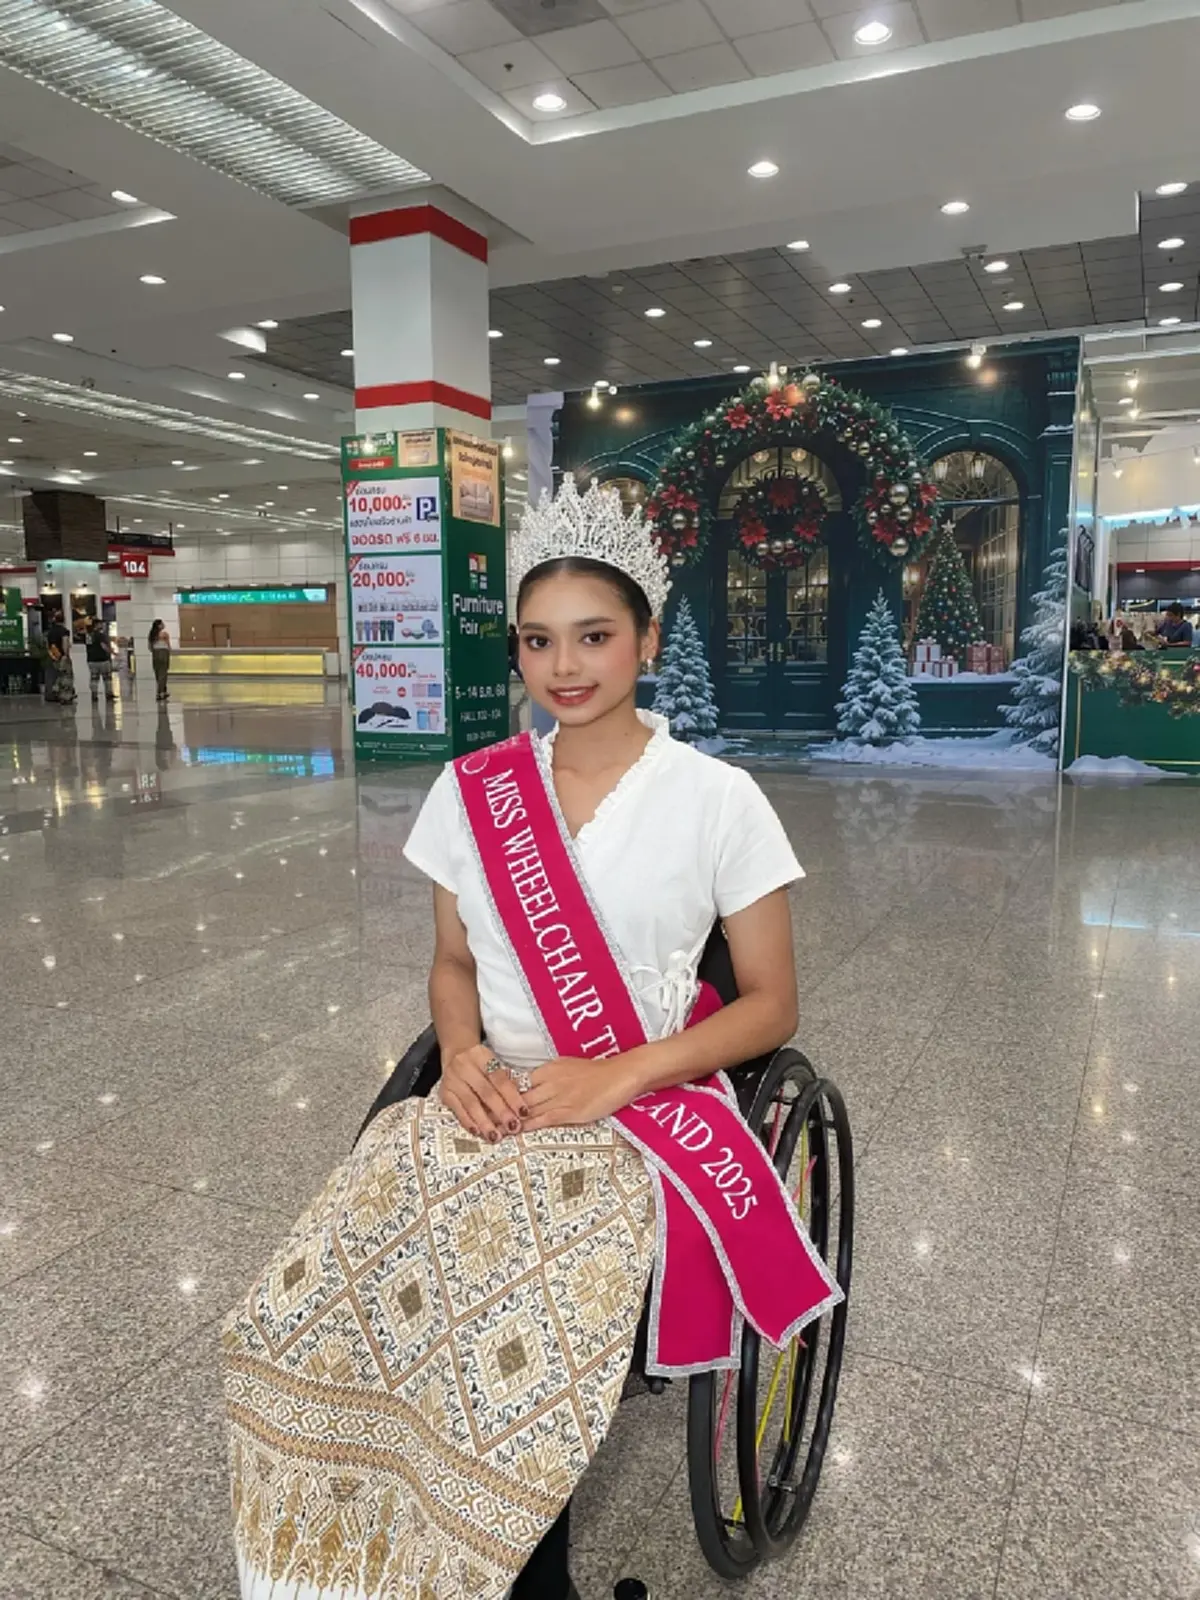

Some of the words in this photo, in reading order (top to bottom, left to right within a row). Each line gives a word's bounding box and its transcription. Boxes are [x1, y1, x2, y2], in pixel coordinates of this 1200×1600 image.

[349, 495, 412, 515] 10,000.-
[419, 498, 432, 519] P
[352, 533, 393, 545] จอดรถ
[413, 533, 421, 543] 6
[124, 561, 145, 574] 104
[352, 572, 415, 590] 20,000.-
[452, 594, 504, 616] Furniture
[459, 616, 478, 635] Fair
[356, 663, 417, 680] 40,000.-
[482, 768, 528, 829] MISS
[502, 824, 603, 1032] WHEELCHAIR
[699, 1147, 759, 1220] 2025
